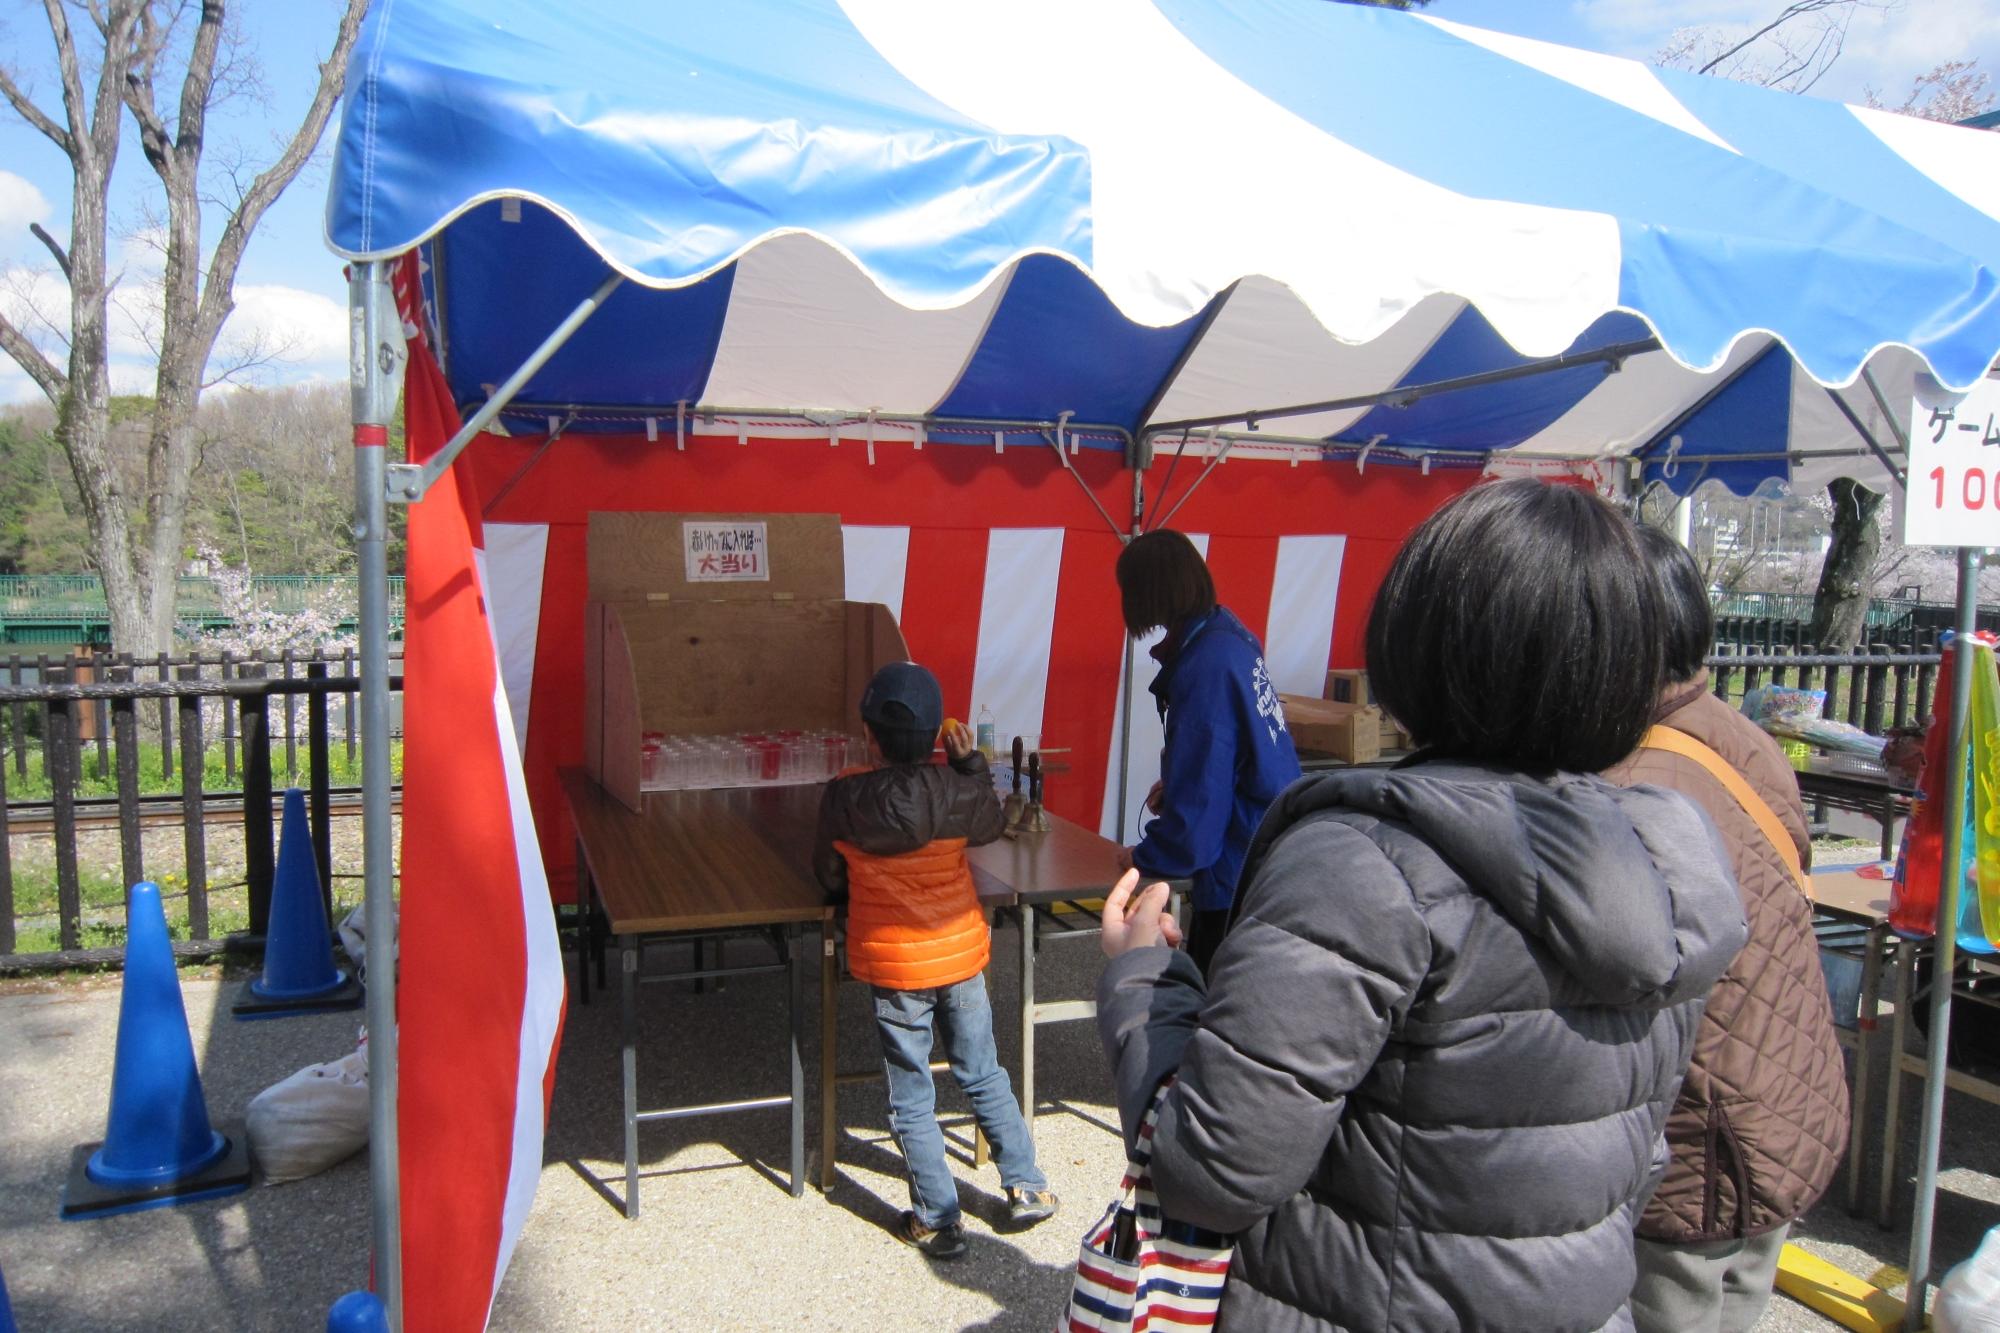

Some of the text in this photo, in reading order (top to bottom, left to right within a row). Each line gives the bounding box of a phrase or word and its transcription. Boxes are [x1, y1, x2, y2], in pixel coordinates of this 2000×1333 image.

[1930, 466, 2000, 511] 10
[698, 553, 757, 575] 大当り
